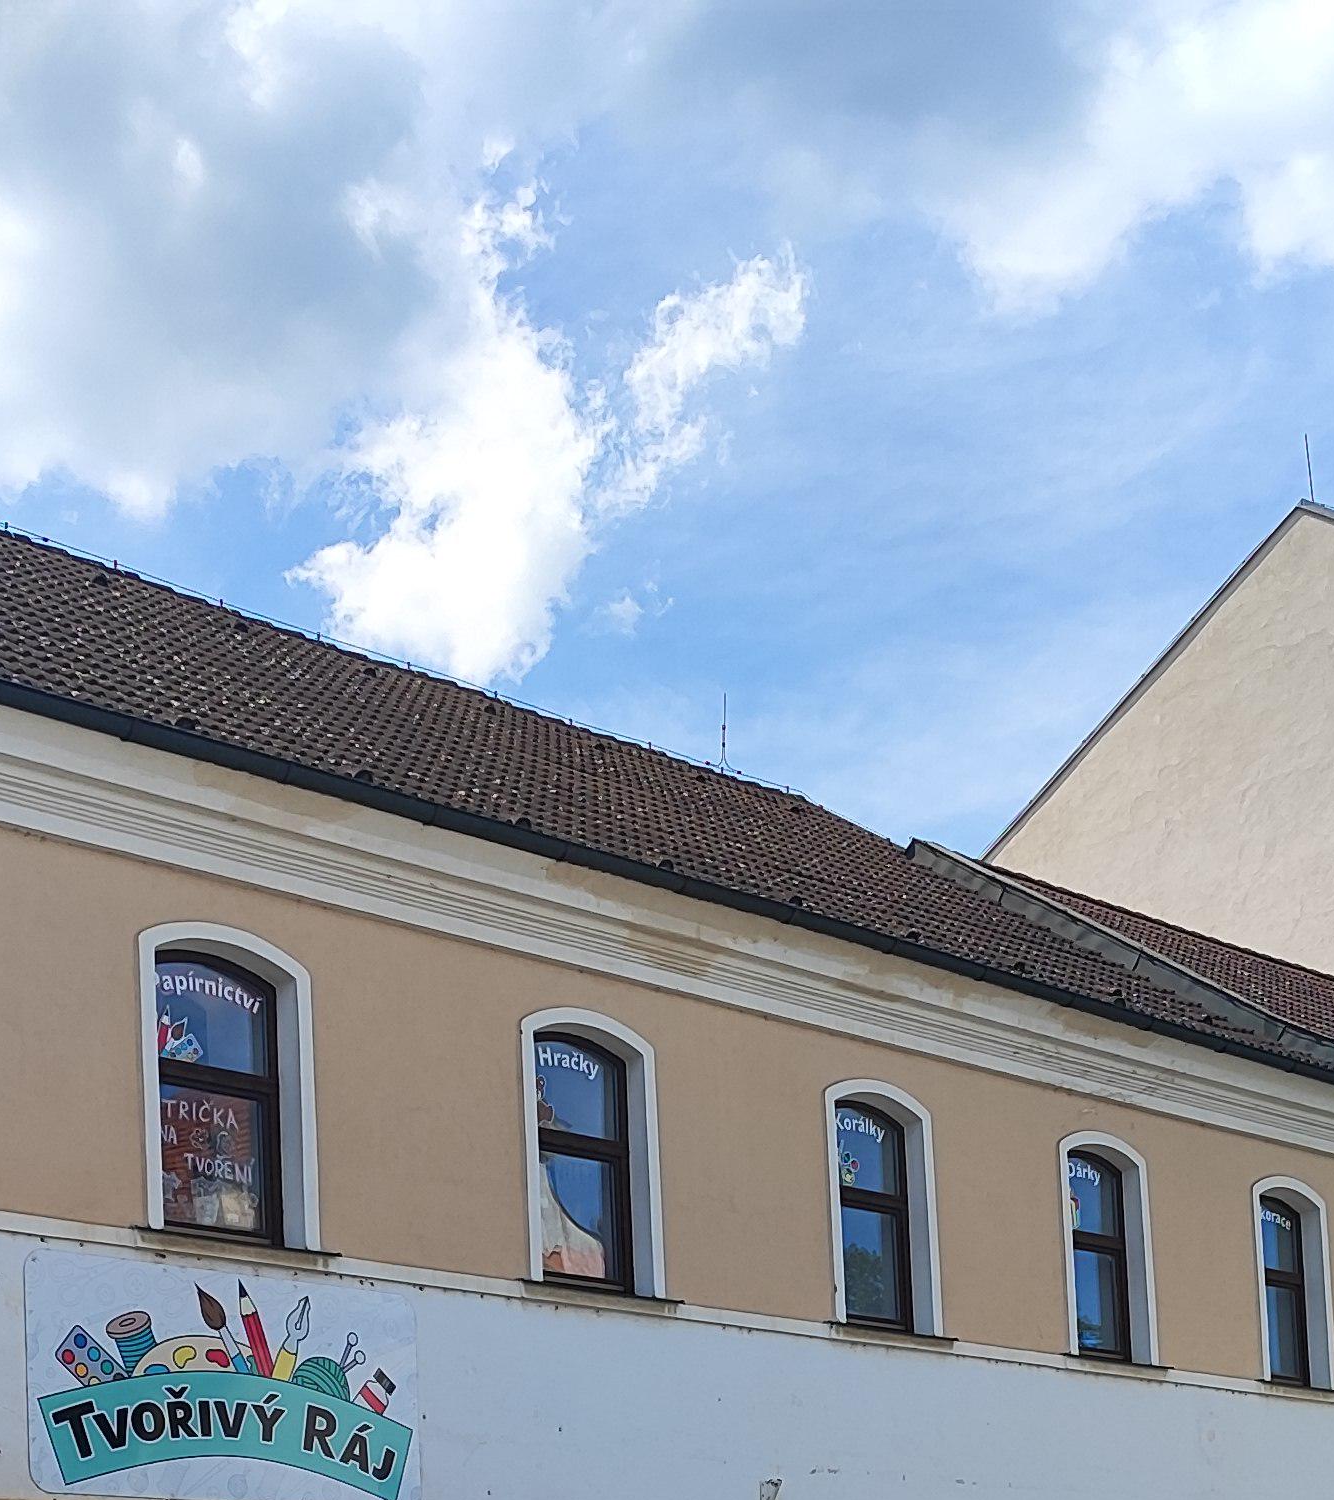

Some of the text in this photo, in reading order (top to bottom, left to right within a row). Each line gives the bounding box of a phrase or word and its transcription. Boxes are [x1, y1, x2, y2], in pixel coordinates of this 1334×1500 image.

[155, 971, 263, 1015] apírnictví
[538, 1046, 599, 1080] Hračky
[161, 1099, 239, 1131] TRIČKA
[184, 1152, 255, 1184] TVOŘENÍ
[1068, 1162, 1101, 1187] Dárky
[51, 1385, 398, 1484] TVOŘIVÝ RÁJ
